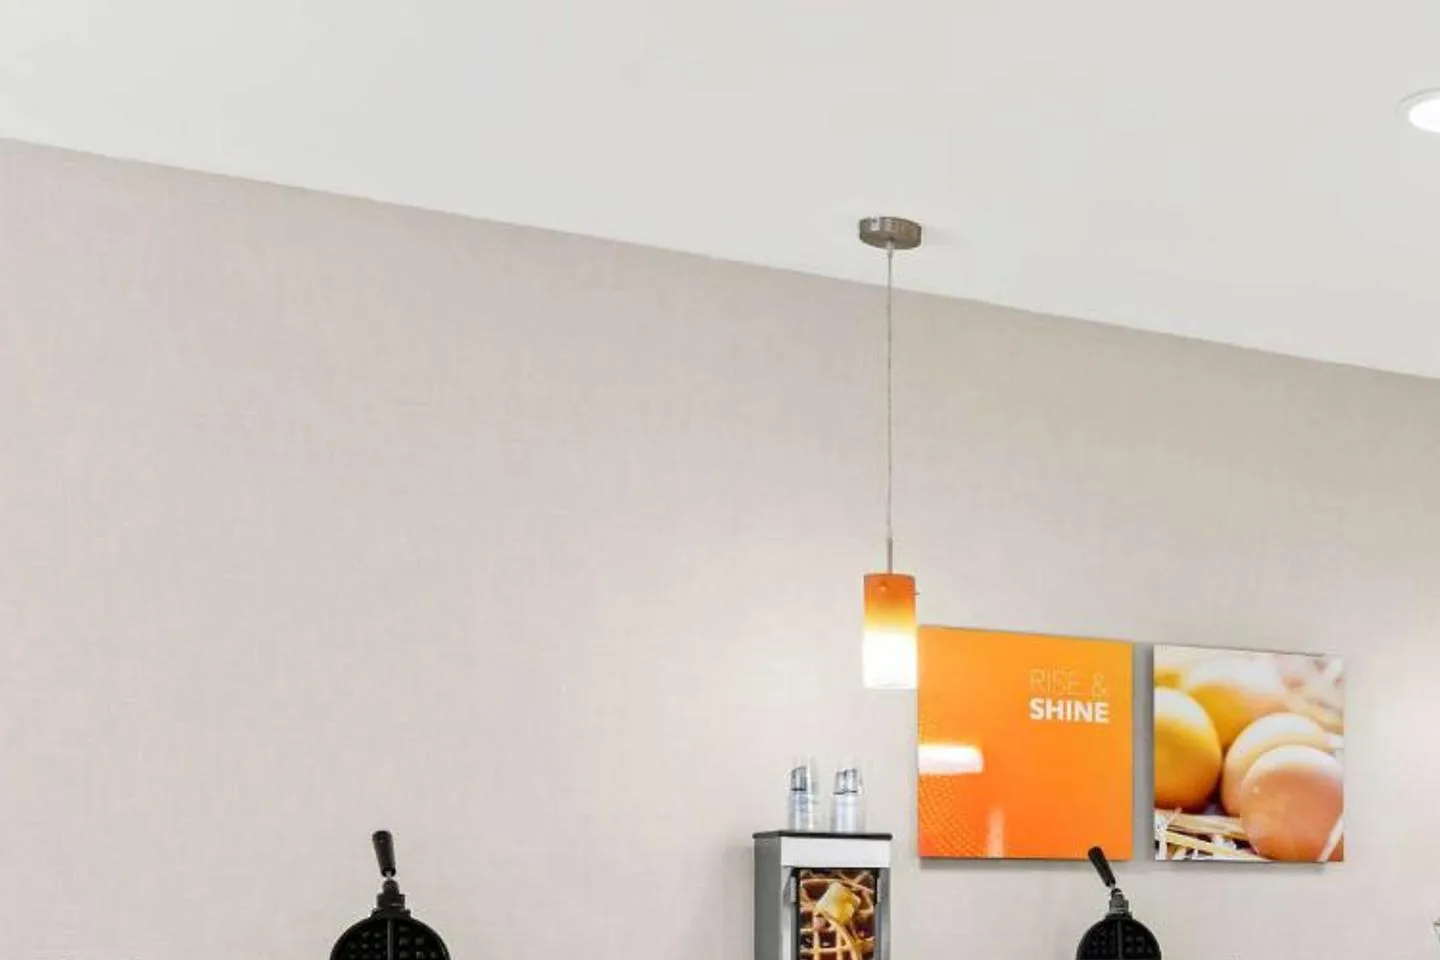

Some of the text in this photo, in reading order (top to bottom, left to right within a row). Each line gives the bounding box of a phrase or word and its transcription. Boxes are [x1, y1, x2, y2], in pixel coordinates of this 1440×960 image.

[1029, 667, 1107, 697] RISE &
[1028, 697, 1109, 724] SHINE
